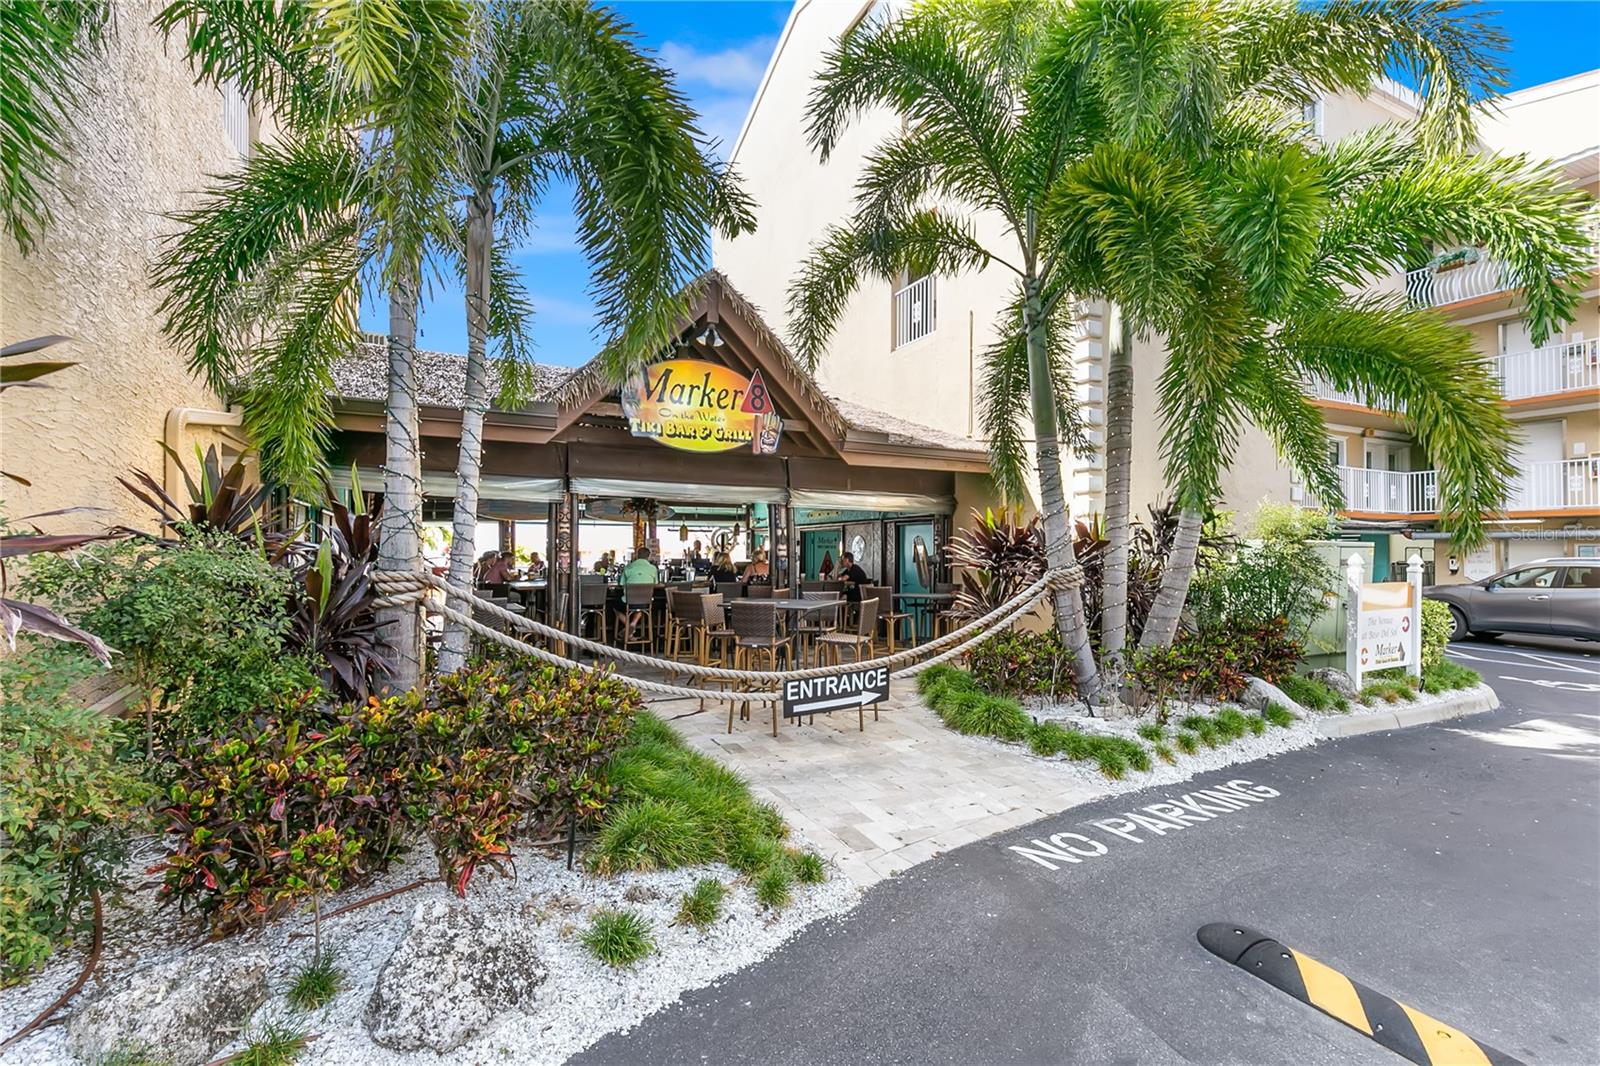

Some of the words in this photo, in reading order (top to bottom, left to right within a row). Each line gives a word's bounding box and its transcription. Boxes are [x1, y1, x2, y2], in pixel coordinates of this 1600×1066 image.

[640, 367, 744, 411] Marker
[750, 383, 766, 411] 8
[681, 411, 695, 420] the
[629, 418, 662, 436] TIKI
[666, 422, 698, 439] BAR
[700, 426, 712, 440] &
[715, 427, 753, 443] GRILL
[1375, 643, 1398, 657] Marker
[787, 668, 887, 701] ENTRANCE
[1008, 832, 1109, 871] NO
[1093, 779, 1281, 843] PARKING
